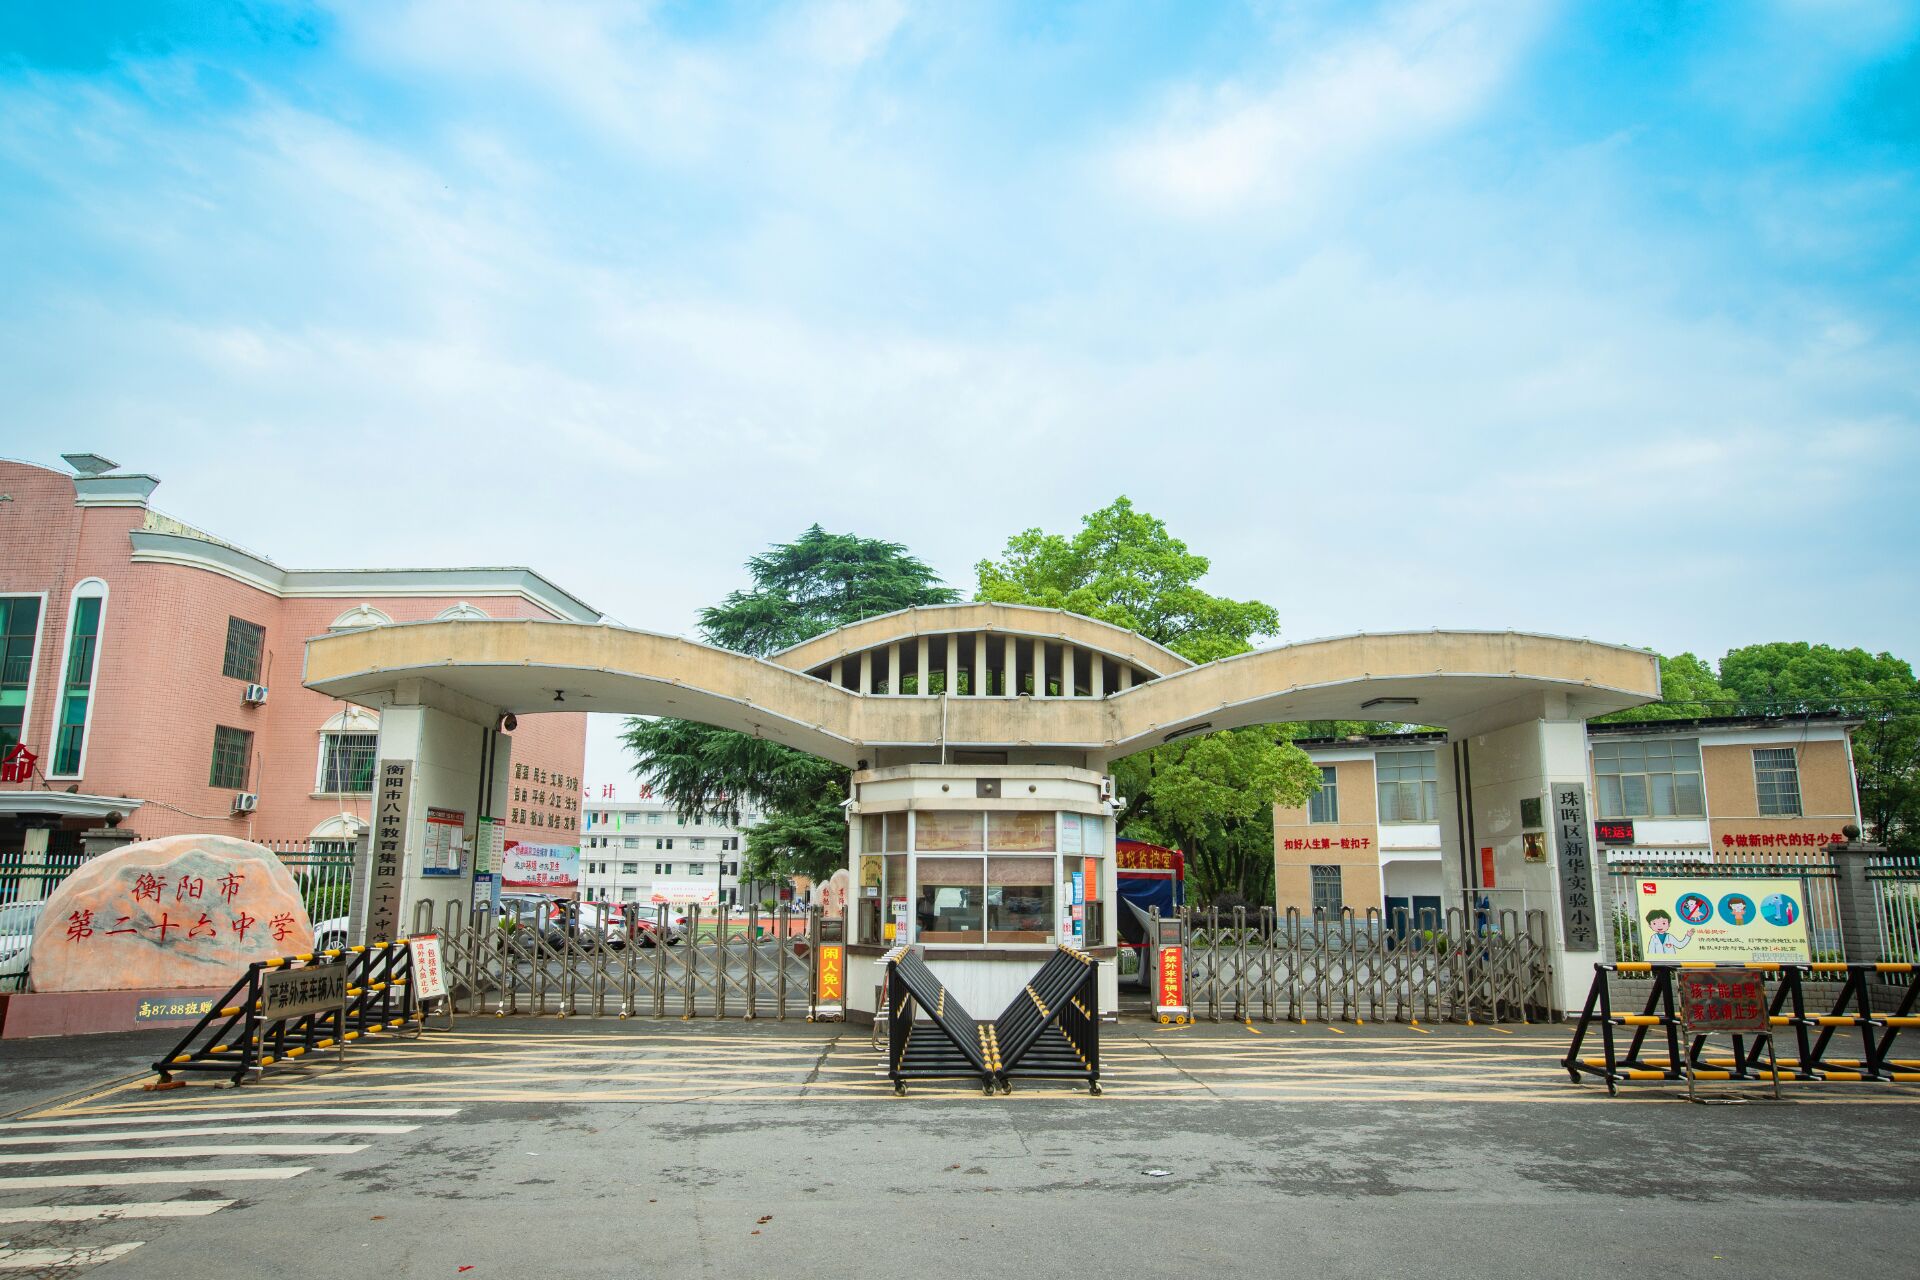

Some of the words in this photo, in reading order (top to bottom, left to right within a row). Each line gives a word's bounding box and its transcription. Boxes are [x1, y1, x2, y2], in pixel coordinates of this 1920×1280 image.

[2, 742, 39, 783] 命
[373, 765, 405, 943] 衡阳市八中教育集团二十六中学
[1284, 838, 1371, 850] 扣好人生第一粒扣子
[1722, 833, 1844, 847] 争做新时代的好少年
[1559, 791, 1591, 942] 珠晖区新华实验小学
[131, 872, 246, 904] 衡阳市
[66, 909, 295, 943] 第二十六中学
[416, 943, 429, 993] 请外来人员止步
[823, 948, 838, 998] 闲人免入
[1165, 948, 1177, 1006] 严禁外来车辆入内
[268, 973, 343, 1010] 严禁外来车辆入内
[1690, 983, 1756, 999] 孩子能自理
[1693, 1003, 1757, 1020] 家长请止步
